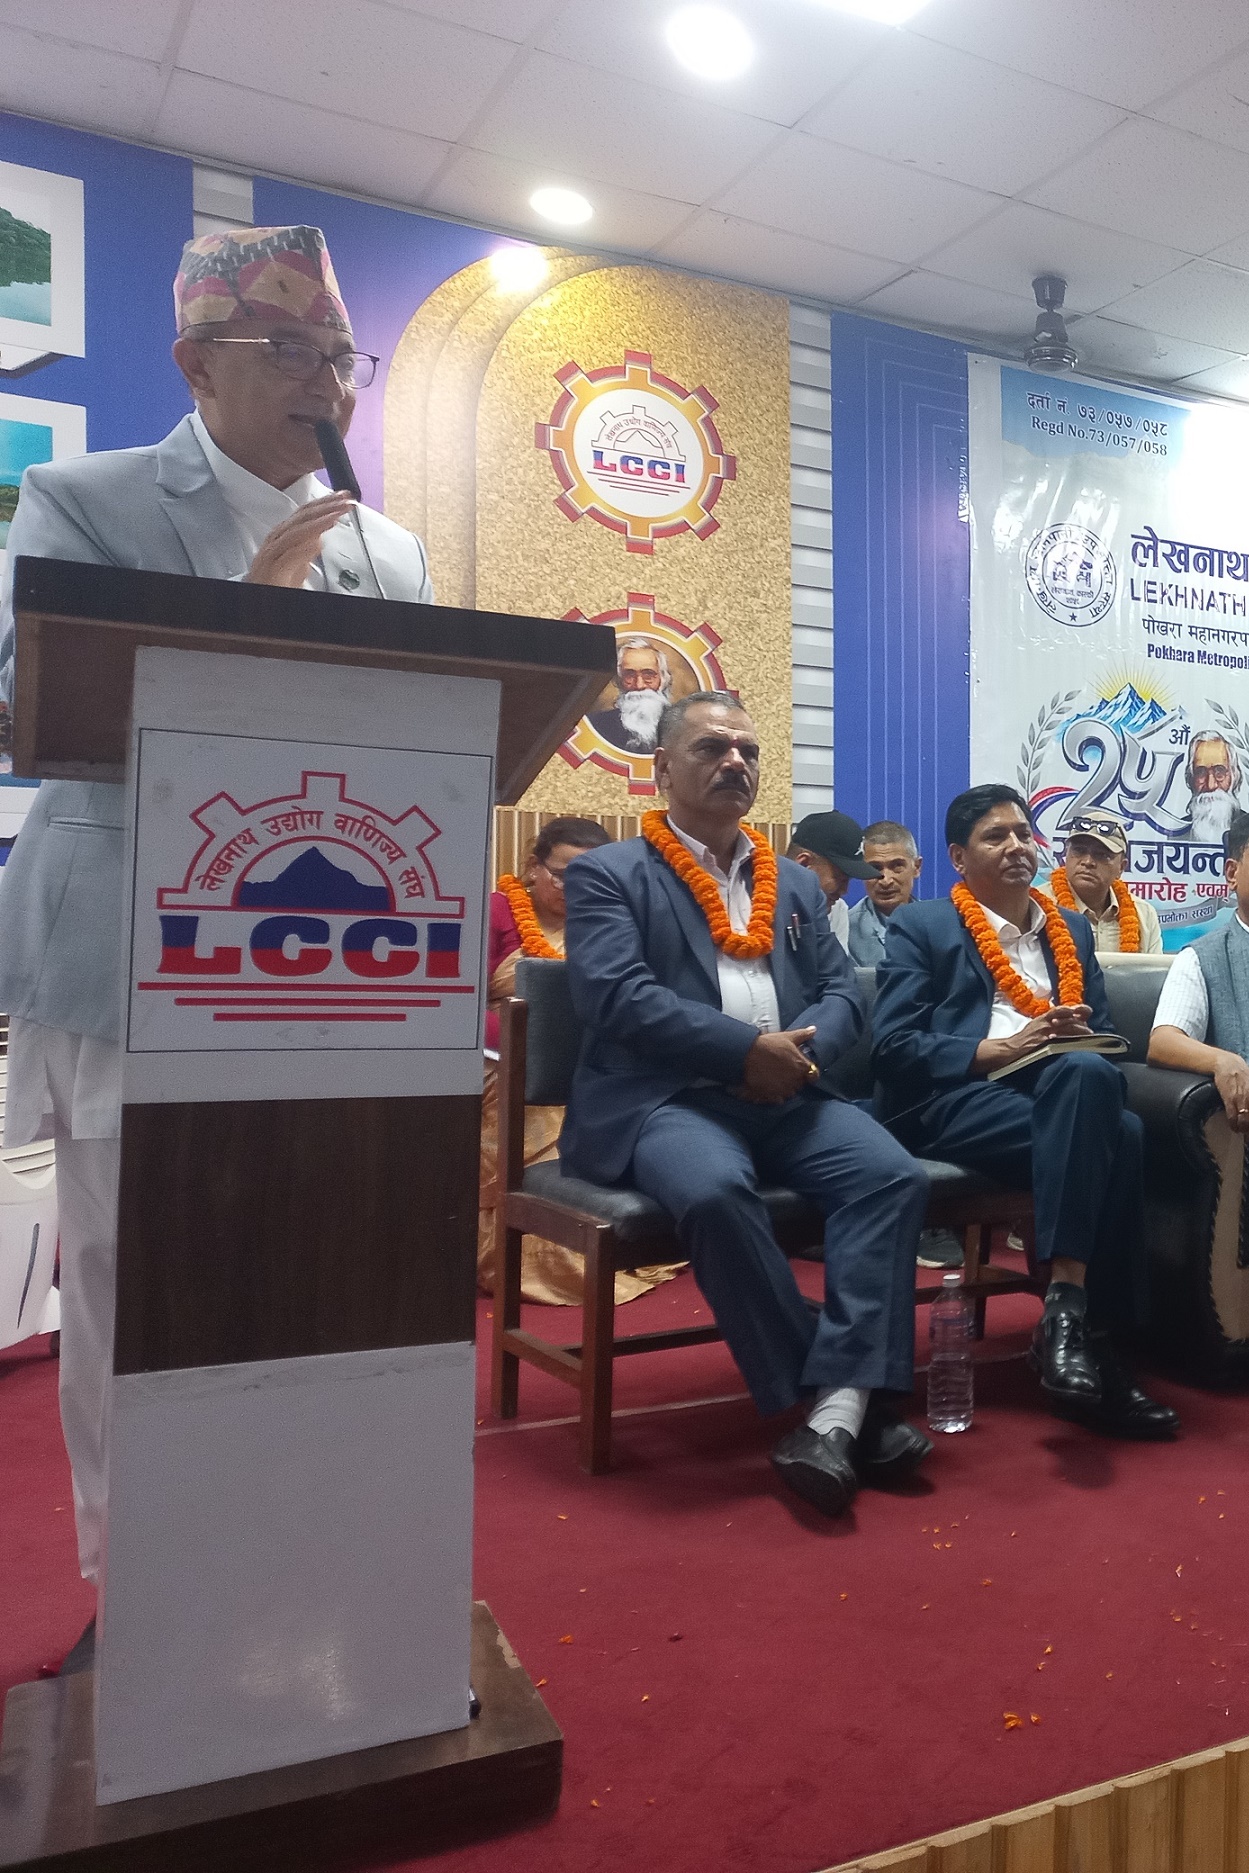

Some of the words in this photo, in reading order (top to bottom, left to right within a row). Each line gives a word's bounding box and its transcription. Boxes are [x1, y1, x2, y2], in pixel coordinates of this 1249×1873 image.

[1032, 416, 1064, 435] Regd
[1068, 424, 1167, 456] No.73/057/058
[592, 449, 685, 483] LCCI
[1131, 578, 1246, 617] LEKHNATH
[1142, 615, 1182, 639] पोखरा
[1147, 643, 1195, 664] Pokhara
[195, 827, 260, 893] लेखनाथ
[261, 805, 325, 836] उद्योग
[334, 813, 407, 865] वाणिज्य
[398, 865, 426, 899] संघ
[156, 915, 462, 978] LCCI
